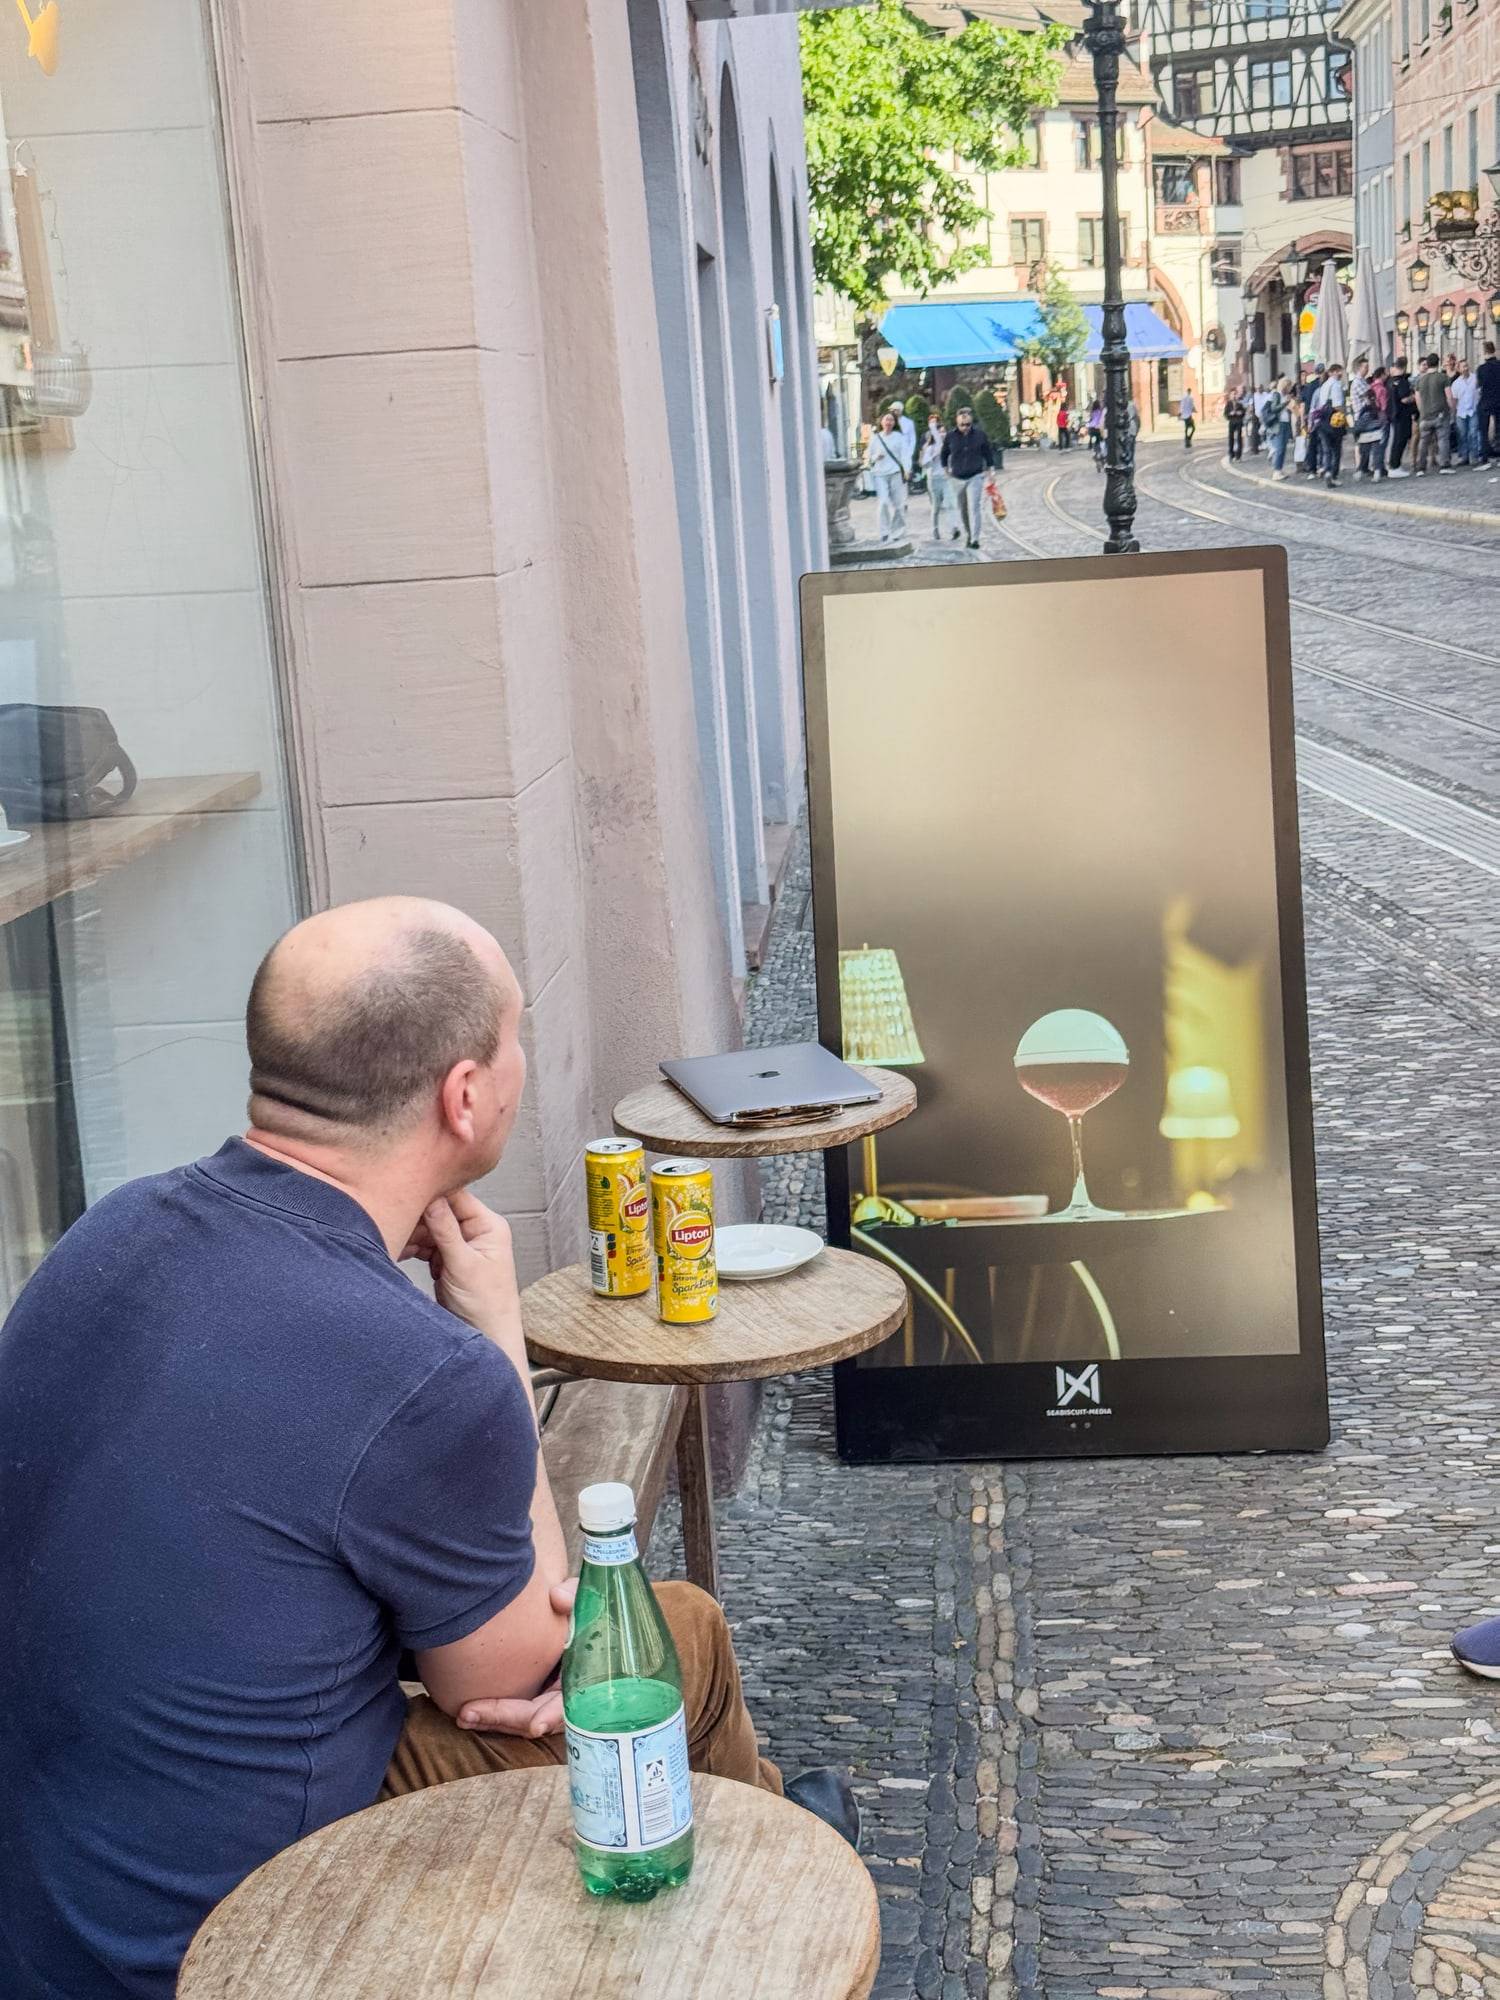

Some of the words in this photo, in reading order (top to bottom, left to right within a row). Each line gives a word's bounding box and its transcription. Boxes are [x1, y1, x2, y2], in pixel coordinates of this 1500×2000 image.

[674, 1228, 709, 1243] Lipton
[672, 1277, 714, 1296] Sparkling
[1046, 1408, 1112, 1416] SEABISCUIT-MEDIA
